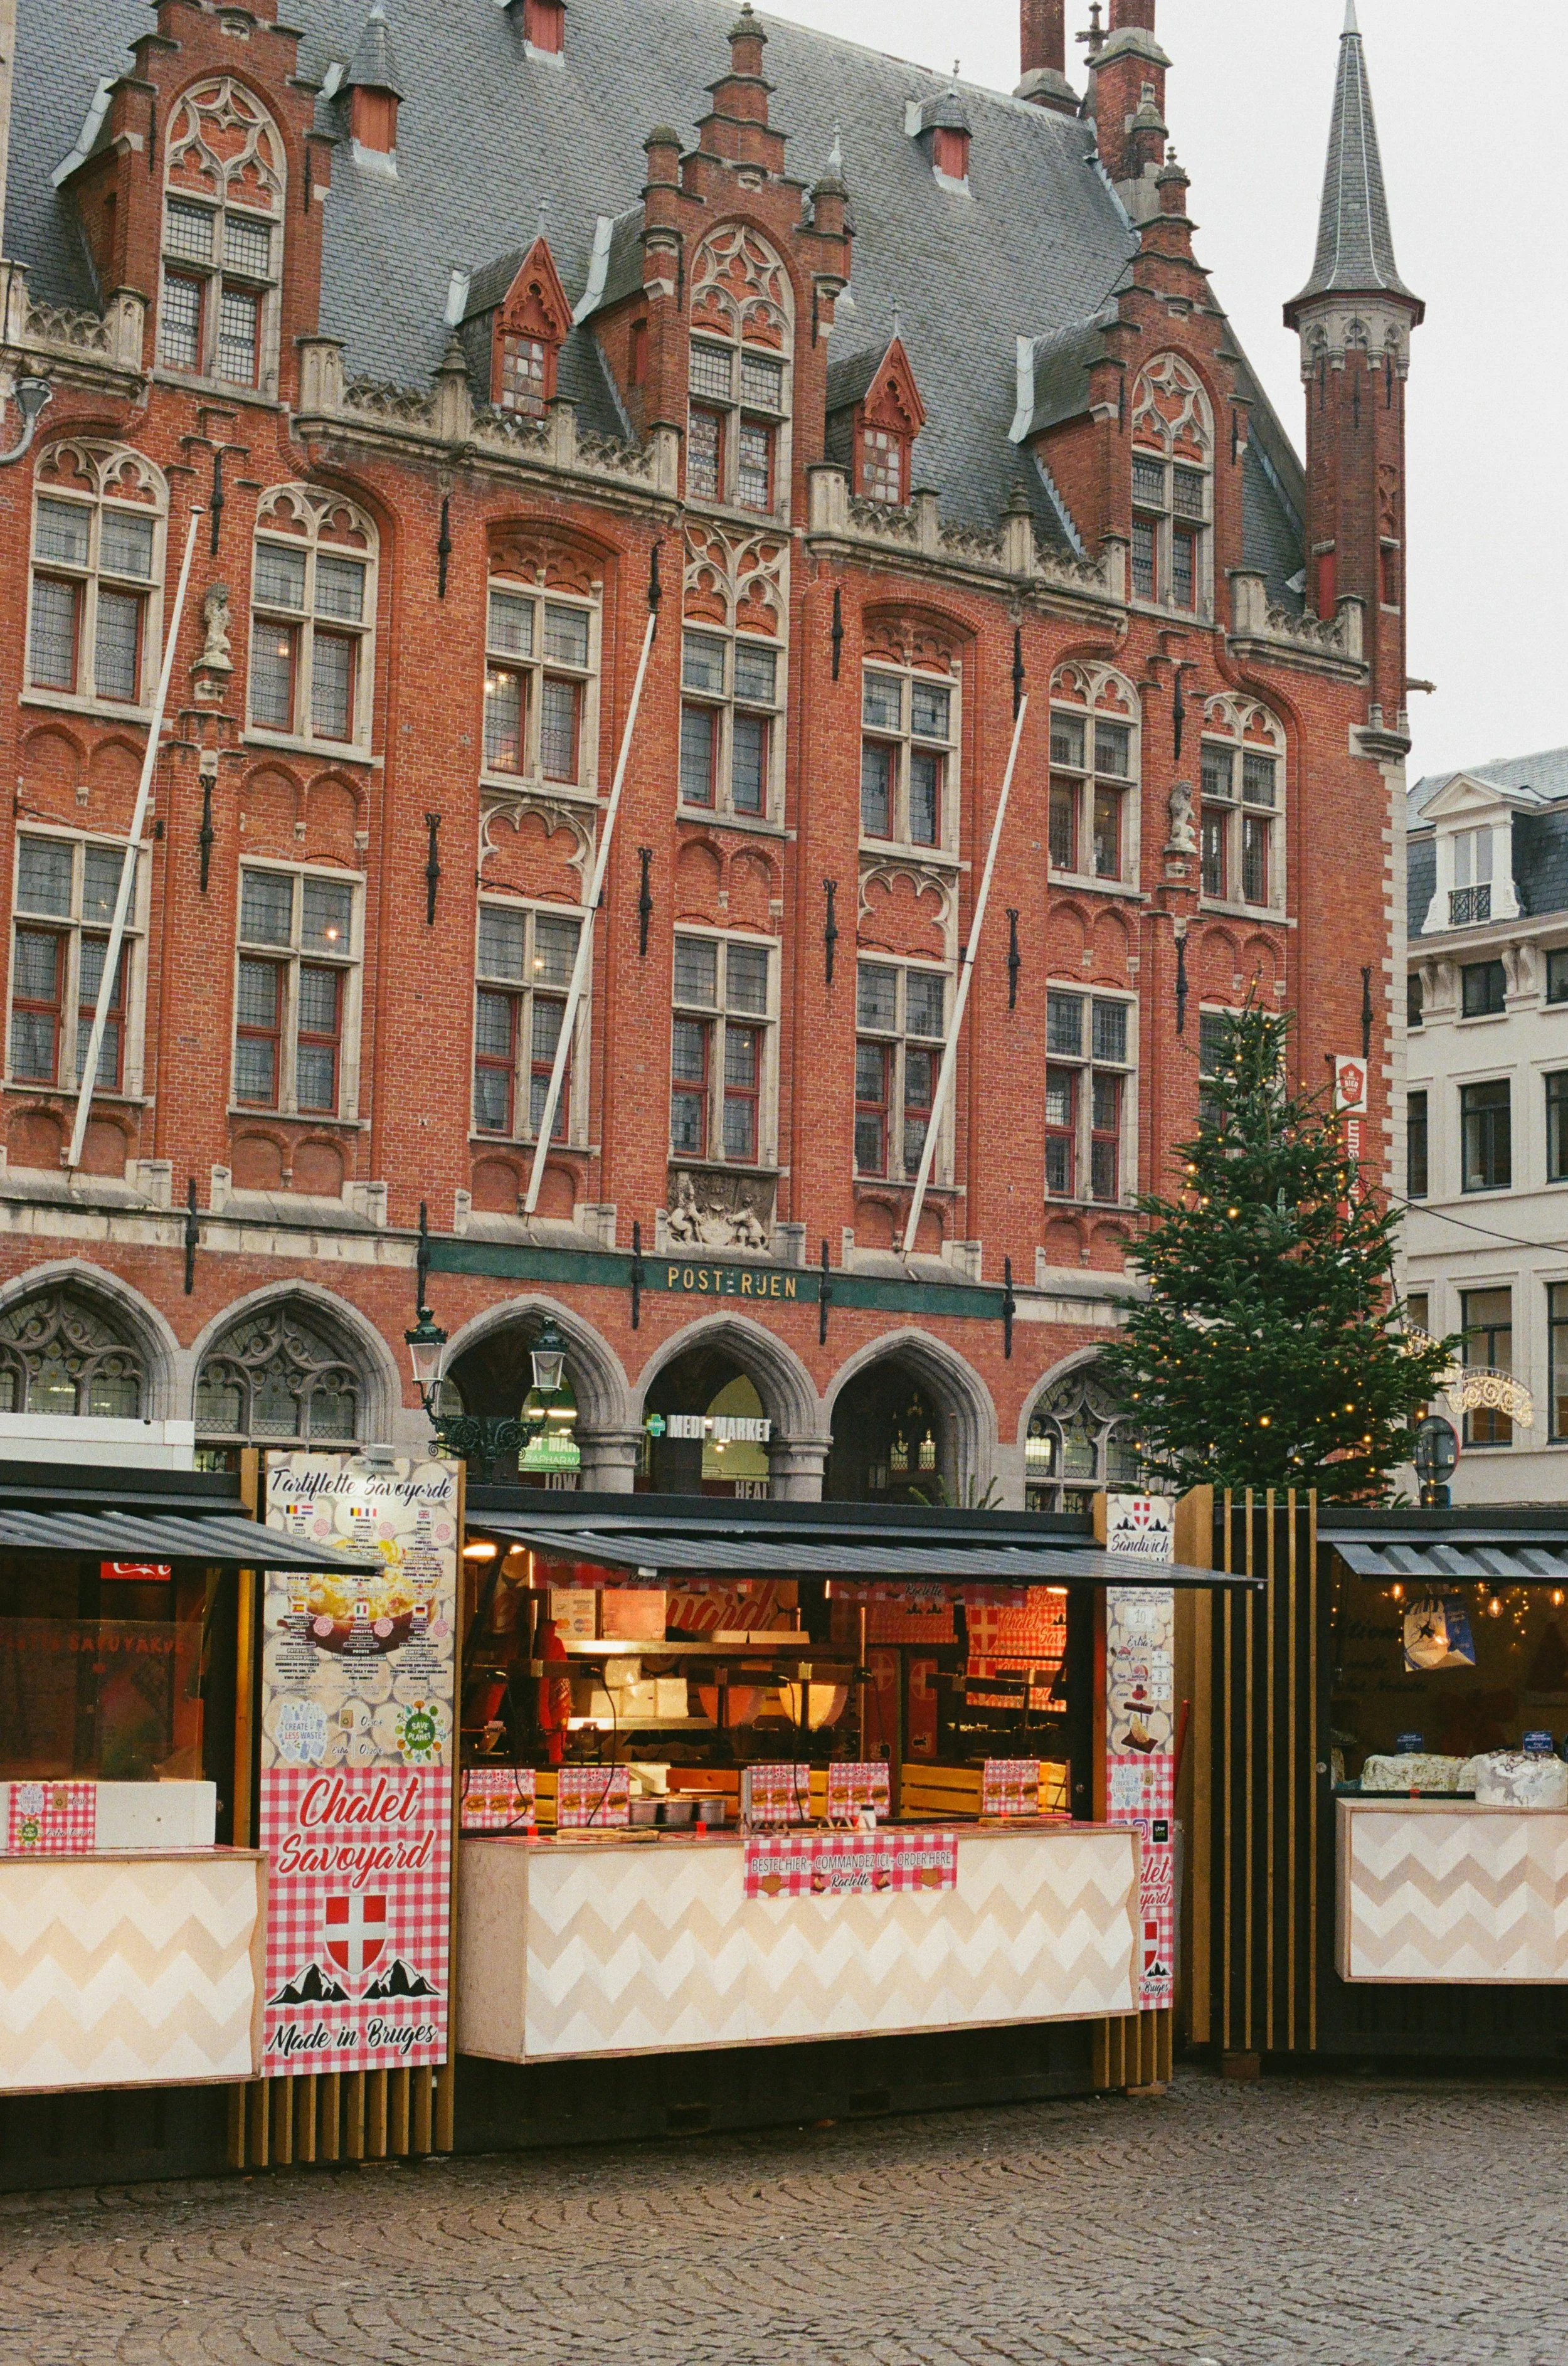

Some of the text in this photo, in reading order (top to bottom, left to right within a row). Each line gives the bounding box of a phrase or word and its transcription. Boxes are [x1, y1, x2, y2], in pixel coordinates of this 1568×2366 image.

[667, 1414, 771, 1442] MEDI MARKET
[272, 1468, 453, 1507] Tartiflette Savoyarde
[1111, 1533, 1168, 1553] Sandwich
[905, 1583, 942, 1597] Raclette
[1001, 1611, 1039, 1630] Chalet
[285, 1722, 308, 1731] CREATE
[300, 1731, 322, 1739] WASTE
[411, 1721, 428, 1730] SAVE
[408, 1732, 431, 1741] PLANET
[299, 1776, 419, 1828] Chalet
[278, 1829, 435, 1889] Savoyard
[752, 1857, 783, 1872] BESTEL
[785, 1857, 807, 1870] HIER
[816, 1854, 874, 1869] COMMANDEZ
[878, 1854, 889, 1867] ICI
[898, 1852, 926, 1866] ORDER
[929, 1851, 950, 1865] HERE
[831, 1872, 871, 1888] Raclette
[1145, 1981, 1169, 1997] Bruges
[267, 2018, 437, 2057] Made in Bruges
